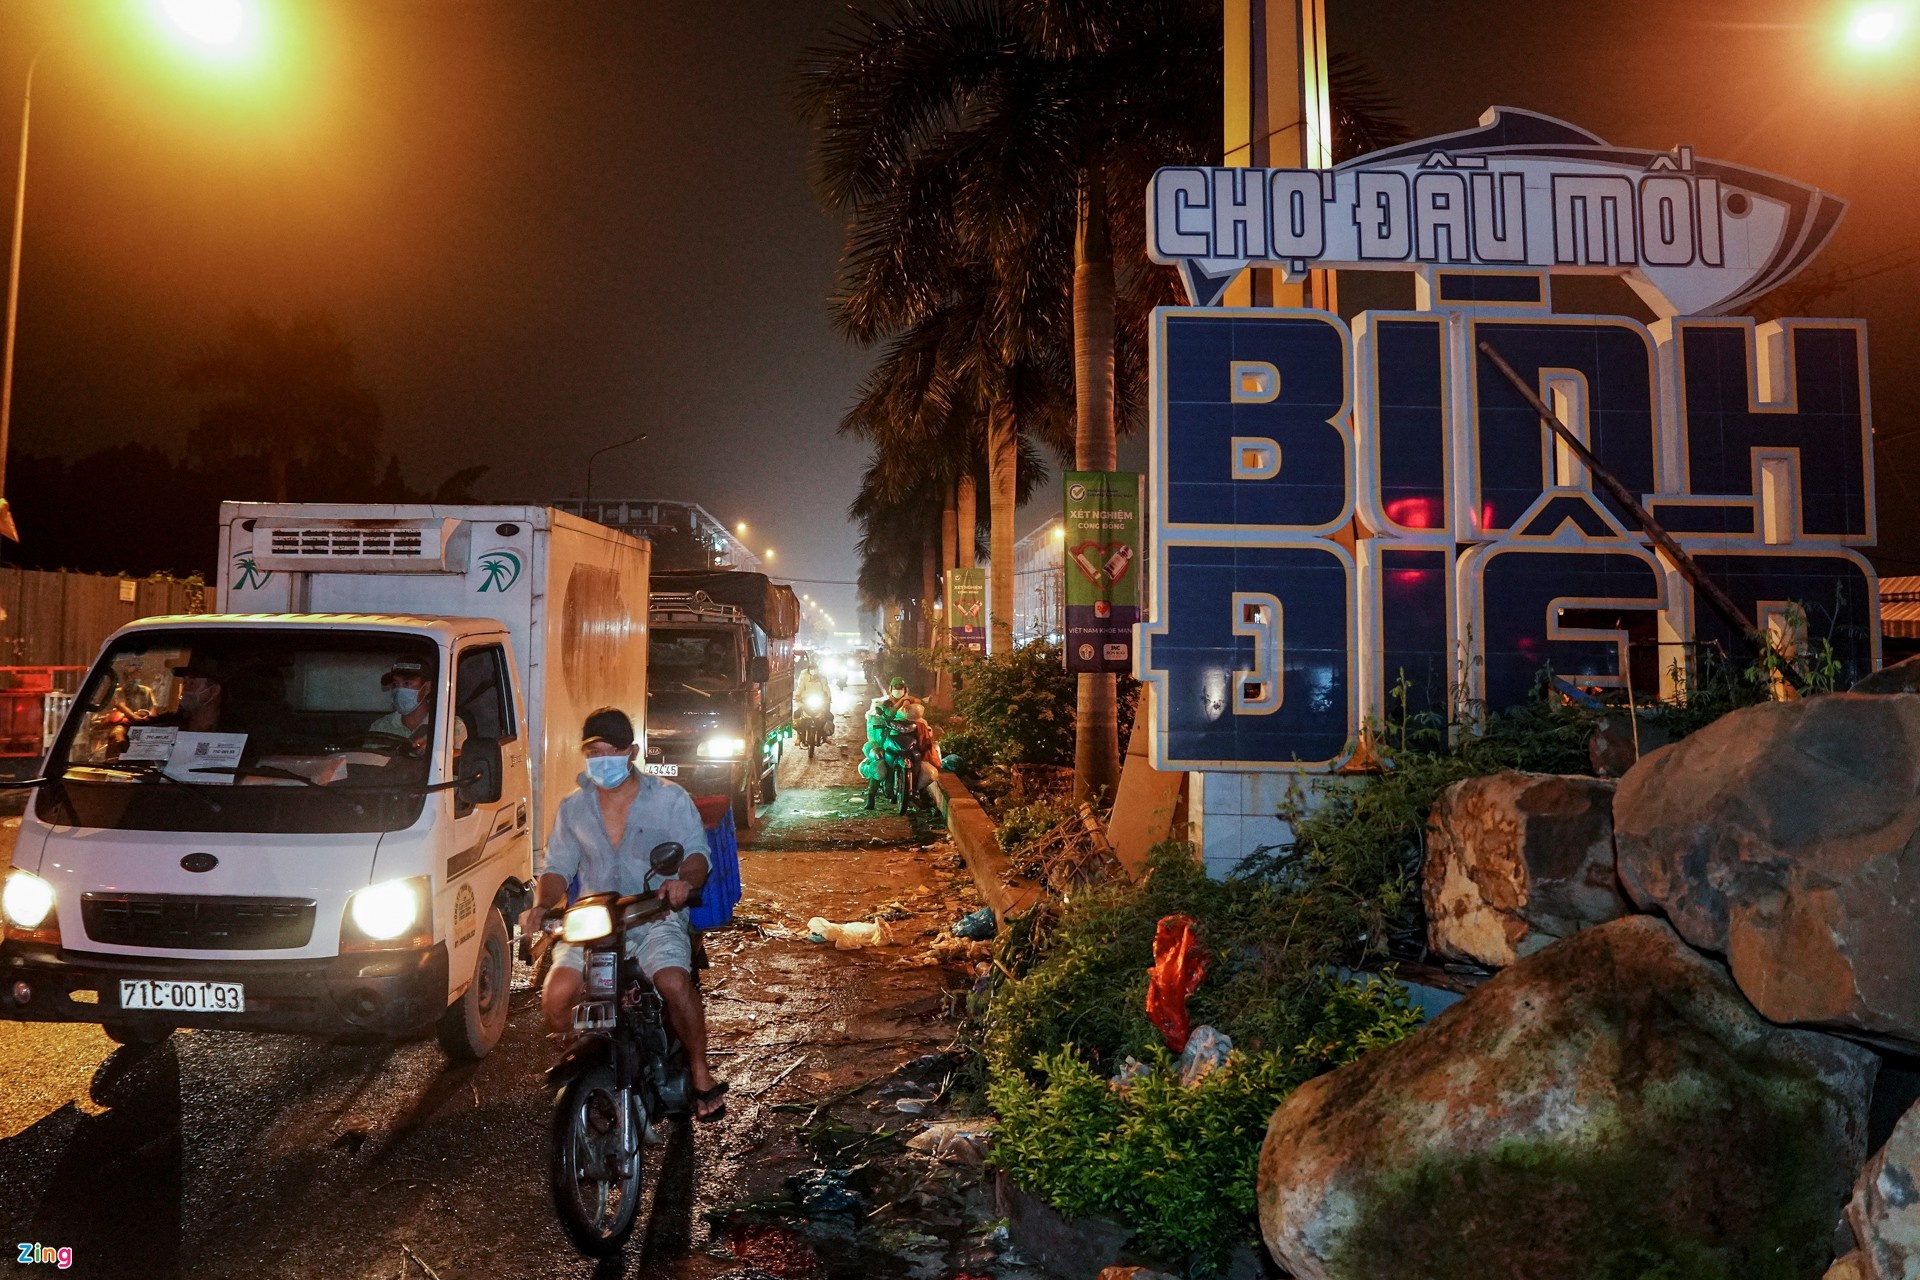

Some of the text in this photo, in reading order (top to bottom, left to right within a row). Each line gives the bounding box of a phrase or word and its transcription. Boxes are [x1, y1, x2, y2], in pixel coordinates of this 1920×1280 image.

[1154, 144, 1725, 273] CHỢ ĐẦU MỐI
[1149, 268, 1877, 546] BÌNH
[1070, 508, 1133, 522] XÉT NGHIỆM
